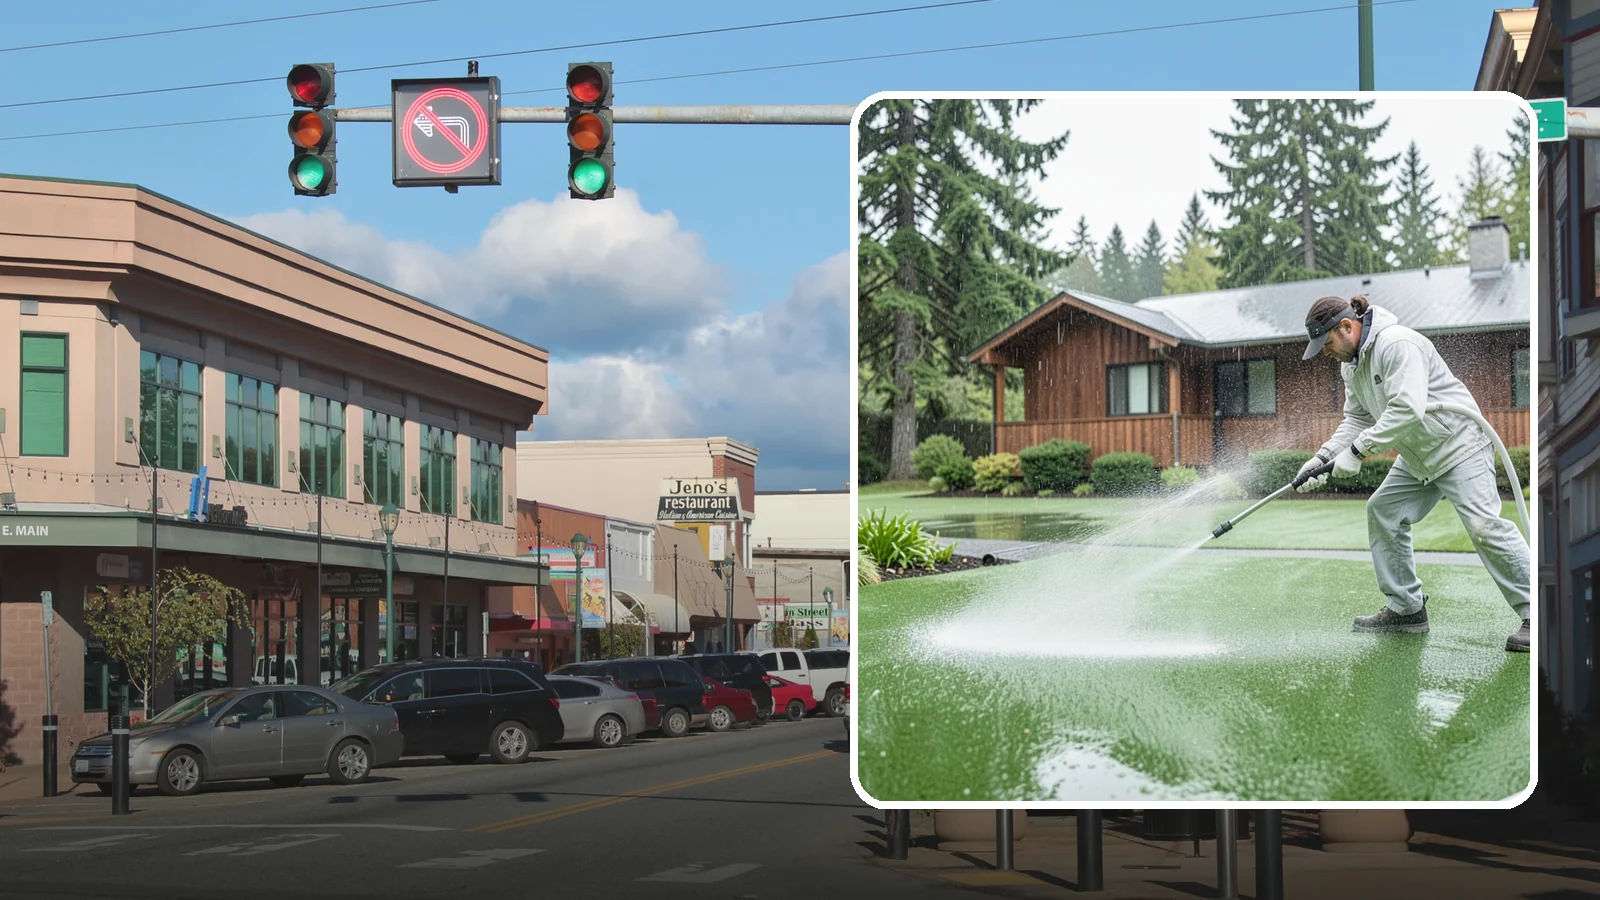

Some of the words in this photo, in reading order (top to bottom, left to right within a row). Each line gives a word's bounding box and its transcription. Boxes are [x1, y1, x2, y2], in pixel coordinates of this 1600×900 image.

[670, 480, 727, 494] Jeno's
[665, 496, 731, 509] restaurant
[659, 510, 682, 519] Italian
[686, 510, 715, 519] American
[715, 510, 737, 519] Cuisine
[2, 525, 13, 536] E.
[15, 525, 49, 536] MAIN
[797, 607, 828, 617] Street
